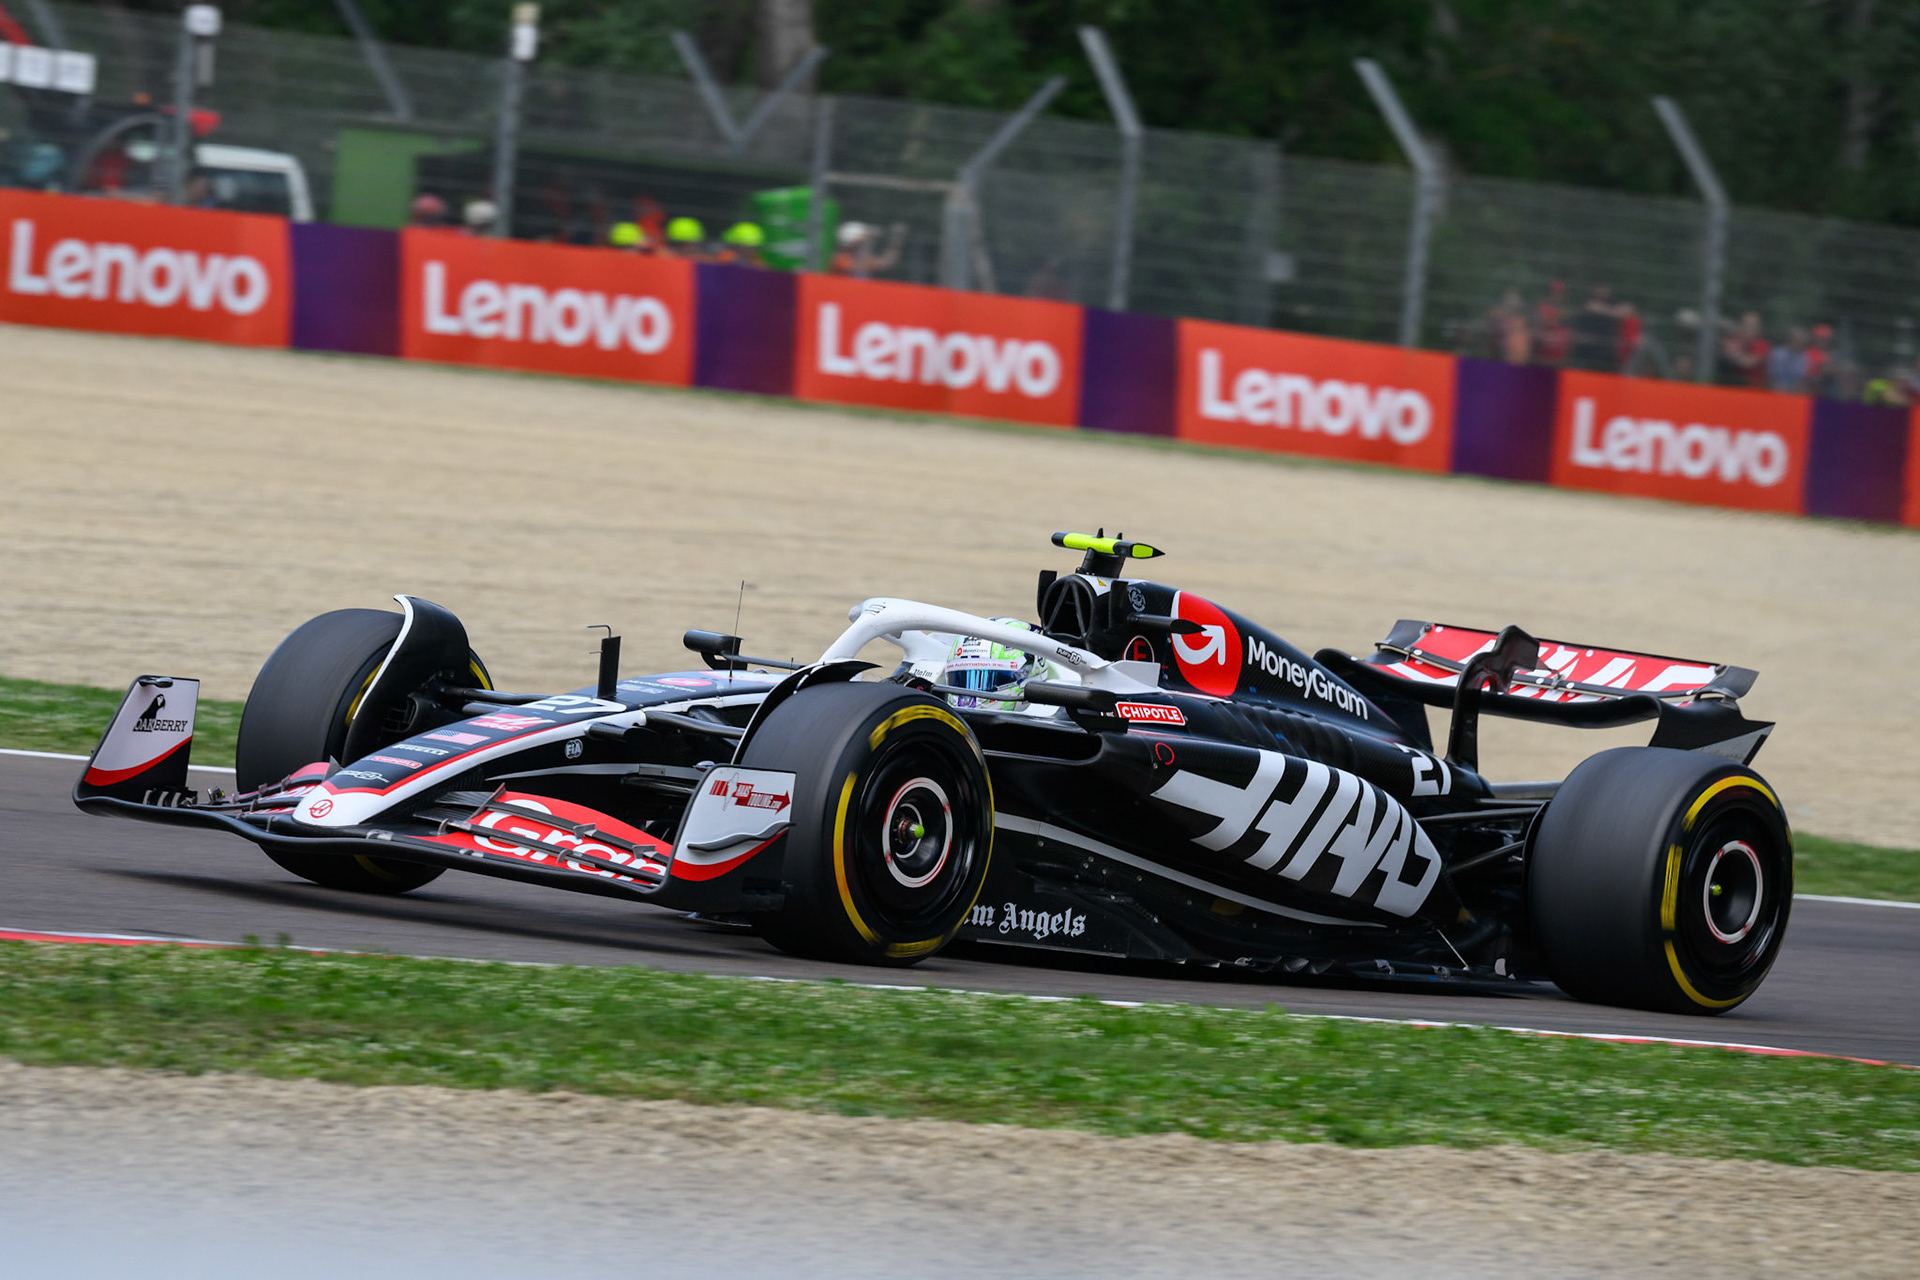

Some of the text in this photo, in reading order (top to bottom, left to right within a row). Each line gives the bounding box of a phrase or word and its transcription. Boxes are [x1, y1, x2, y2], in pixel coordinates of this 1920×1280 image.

[9, 219, 269, 315] Lenovo
[423, 260, 673, 355] Lenovo
[817, 302, 1061, 397] Lenovo
[1198, 348, 1432, 445] Lenovo
[1571, 398, 1788, 487] Lenovo
[519, 695, 627, 714] 27
[1121, 706, 1181, 720] CHIPOTLE
[1247, 635, 1369, 720] MoneyGram
[132, 718, 188, 733] OAKBERRY
[566, 741, 582, 757] FIA
[999, 902, 1087, 940] Angels
